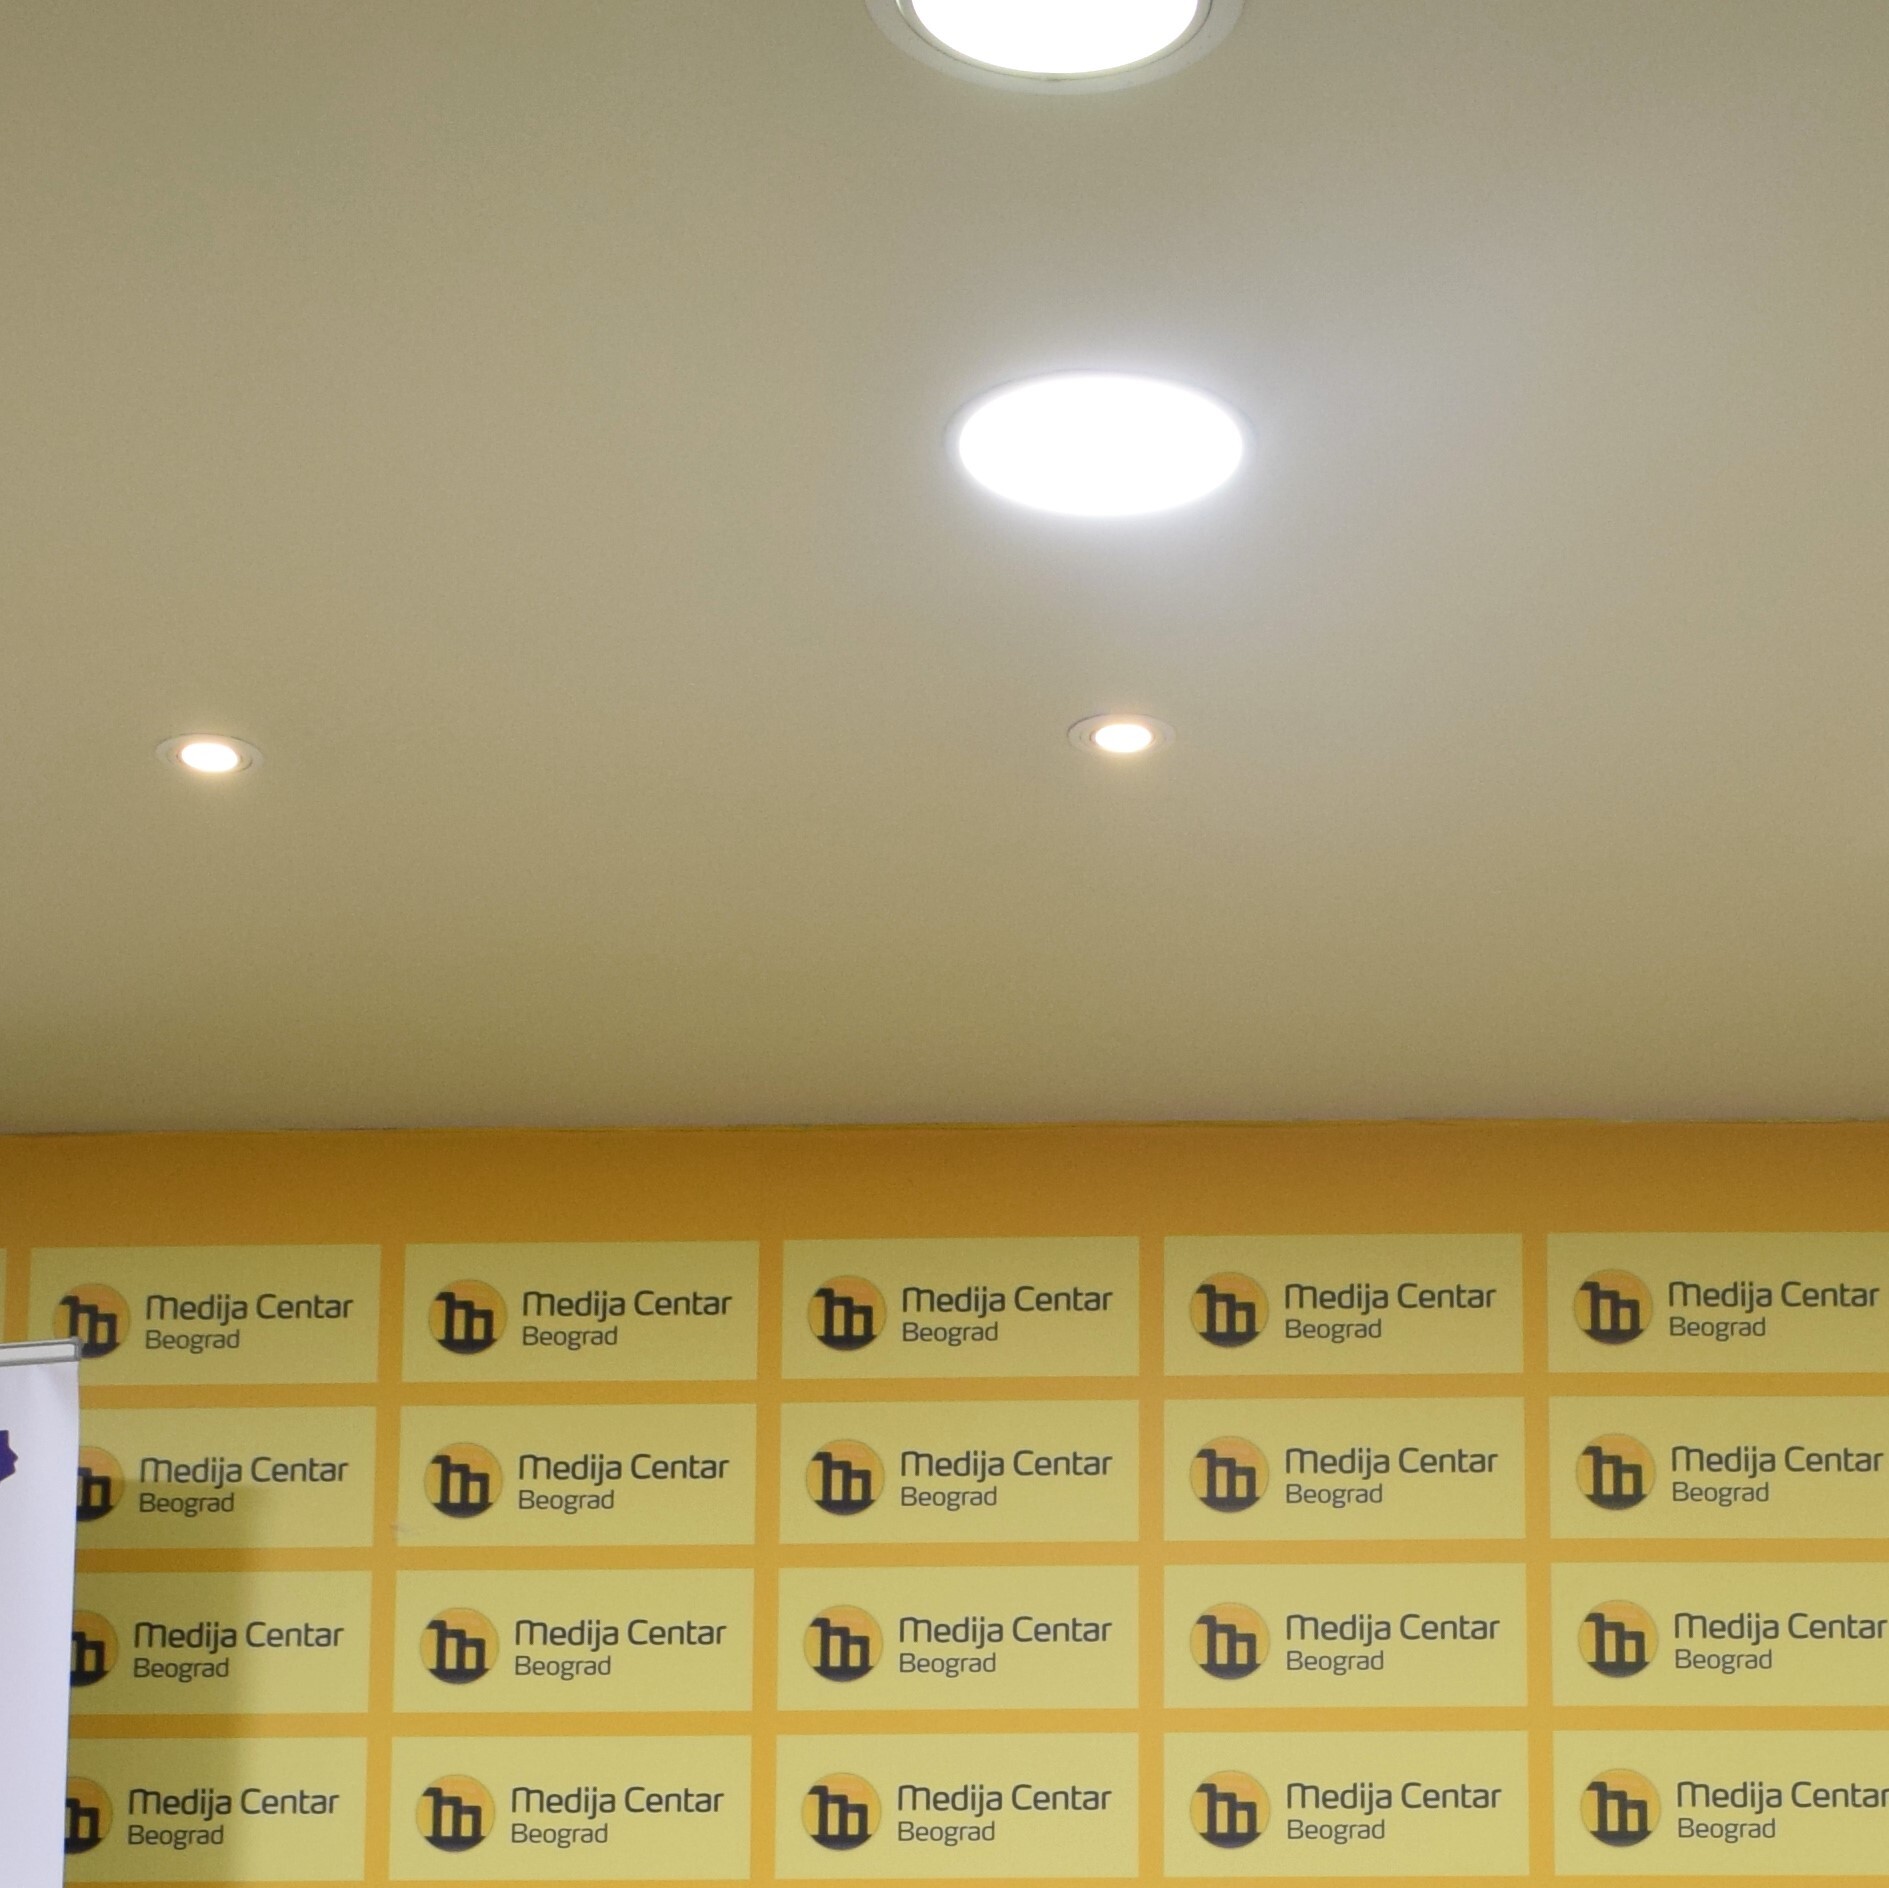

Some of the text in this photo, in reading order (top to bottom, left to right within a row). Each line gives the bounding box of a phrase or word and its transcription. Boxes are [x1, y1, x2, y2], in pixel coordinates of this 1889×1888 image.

[522, 1289, 733, 1324] Medija Centar
[522, 1324, 619, 1351] Beograd
[1286, 1613, 1501, 1647] Medija Centar
[1286, 1649, 1385, 1677] Beograd
